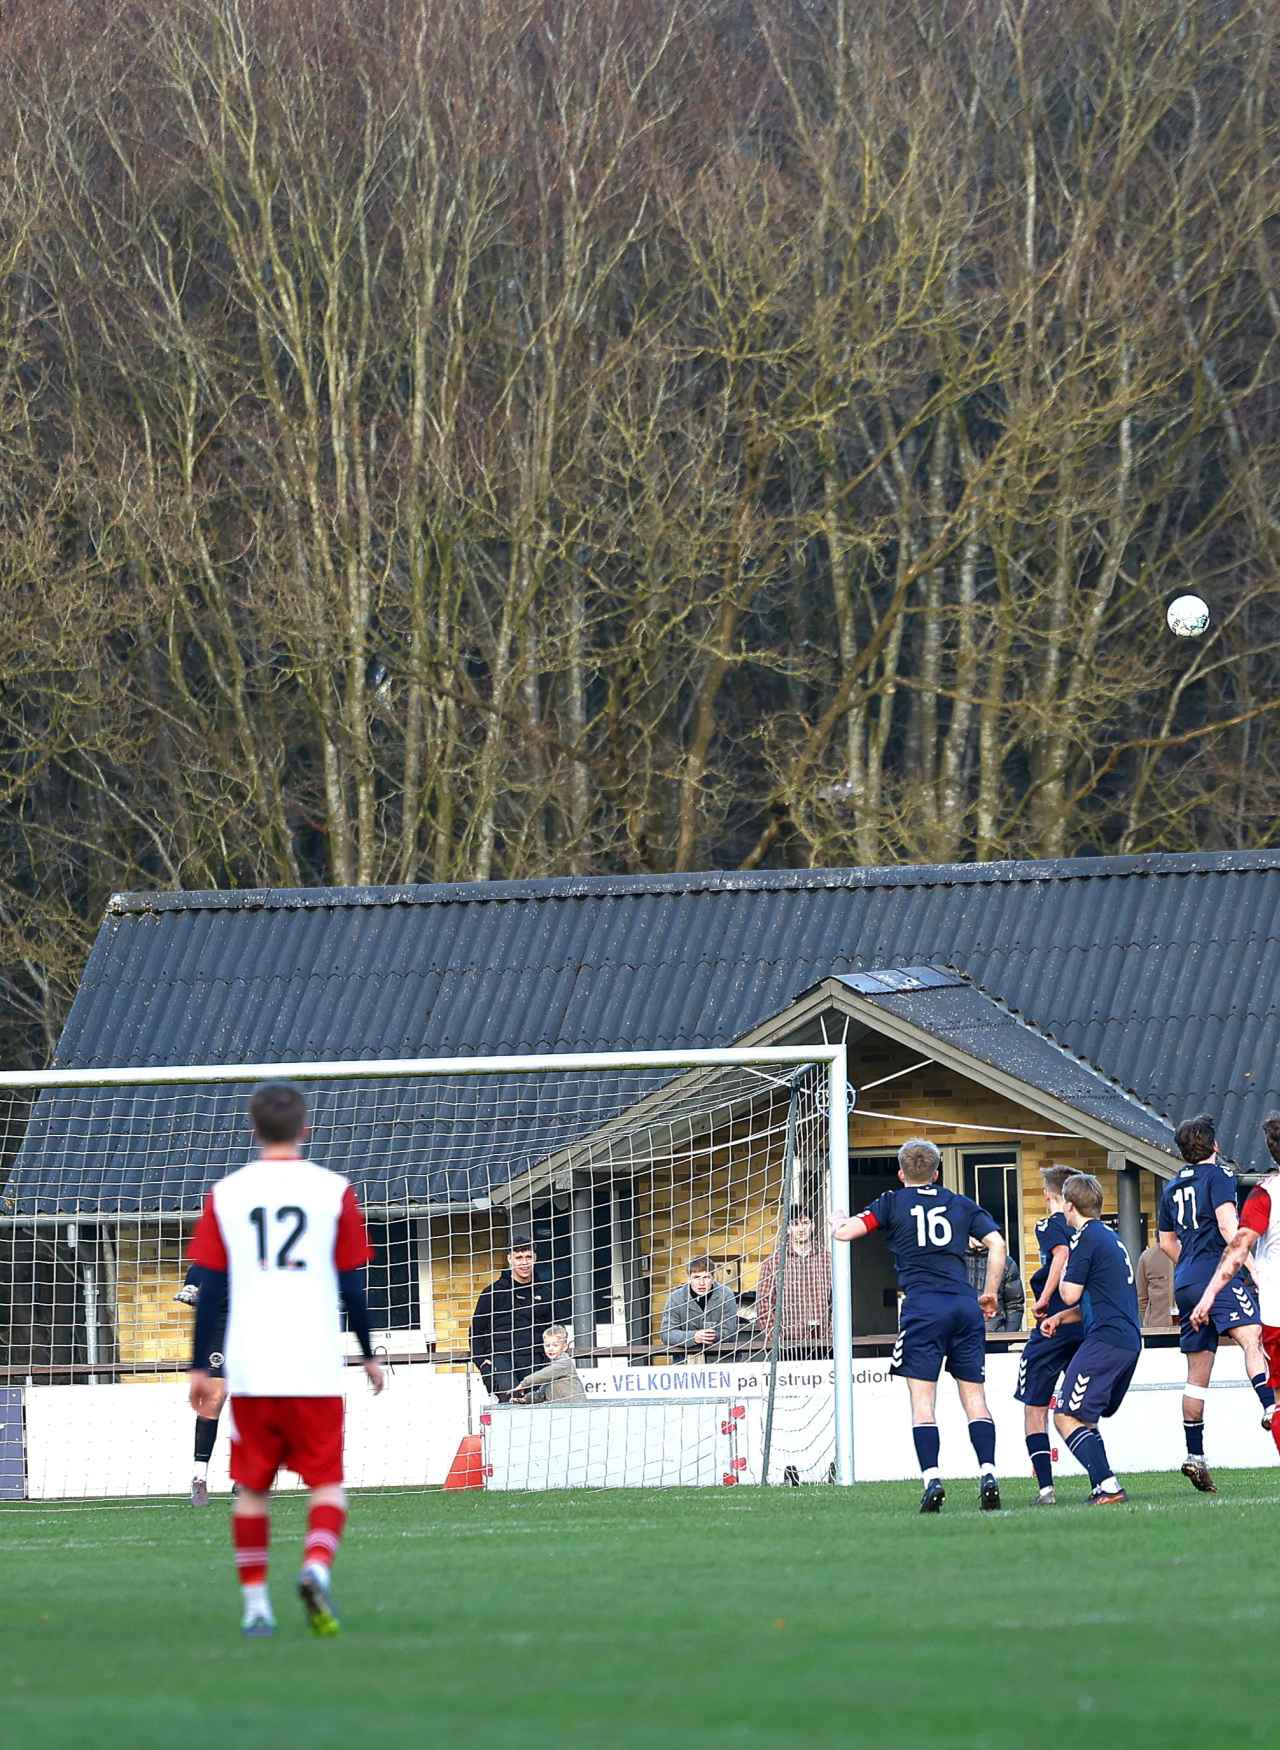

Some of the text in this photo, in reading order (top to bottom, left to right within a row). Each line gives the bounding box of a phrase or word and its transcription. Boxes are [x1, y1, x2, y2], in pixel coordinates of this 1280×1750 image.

[910, 1204, 952, 1247] 16
[1172, 1185, 1199, 1230] 17
[248, 1205, 307, 1271] 12
[612, 1370, 731, 1393] VELKOMMEN
[763, 1371, 822, 1389] Tstrup
